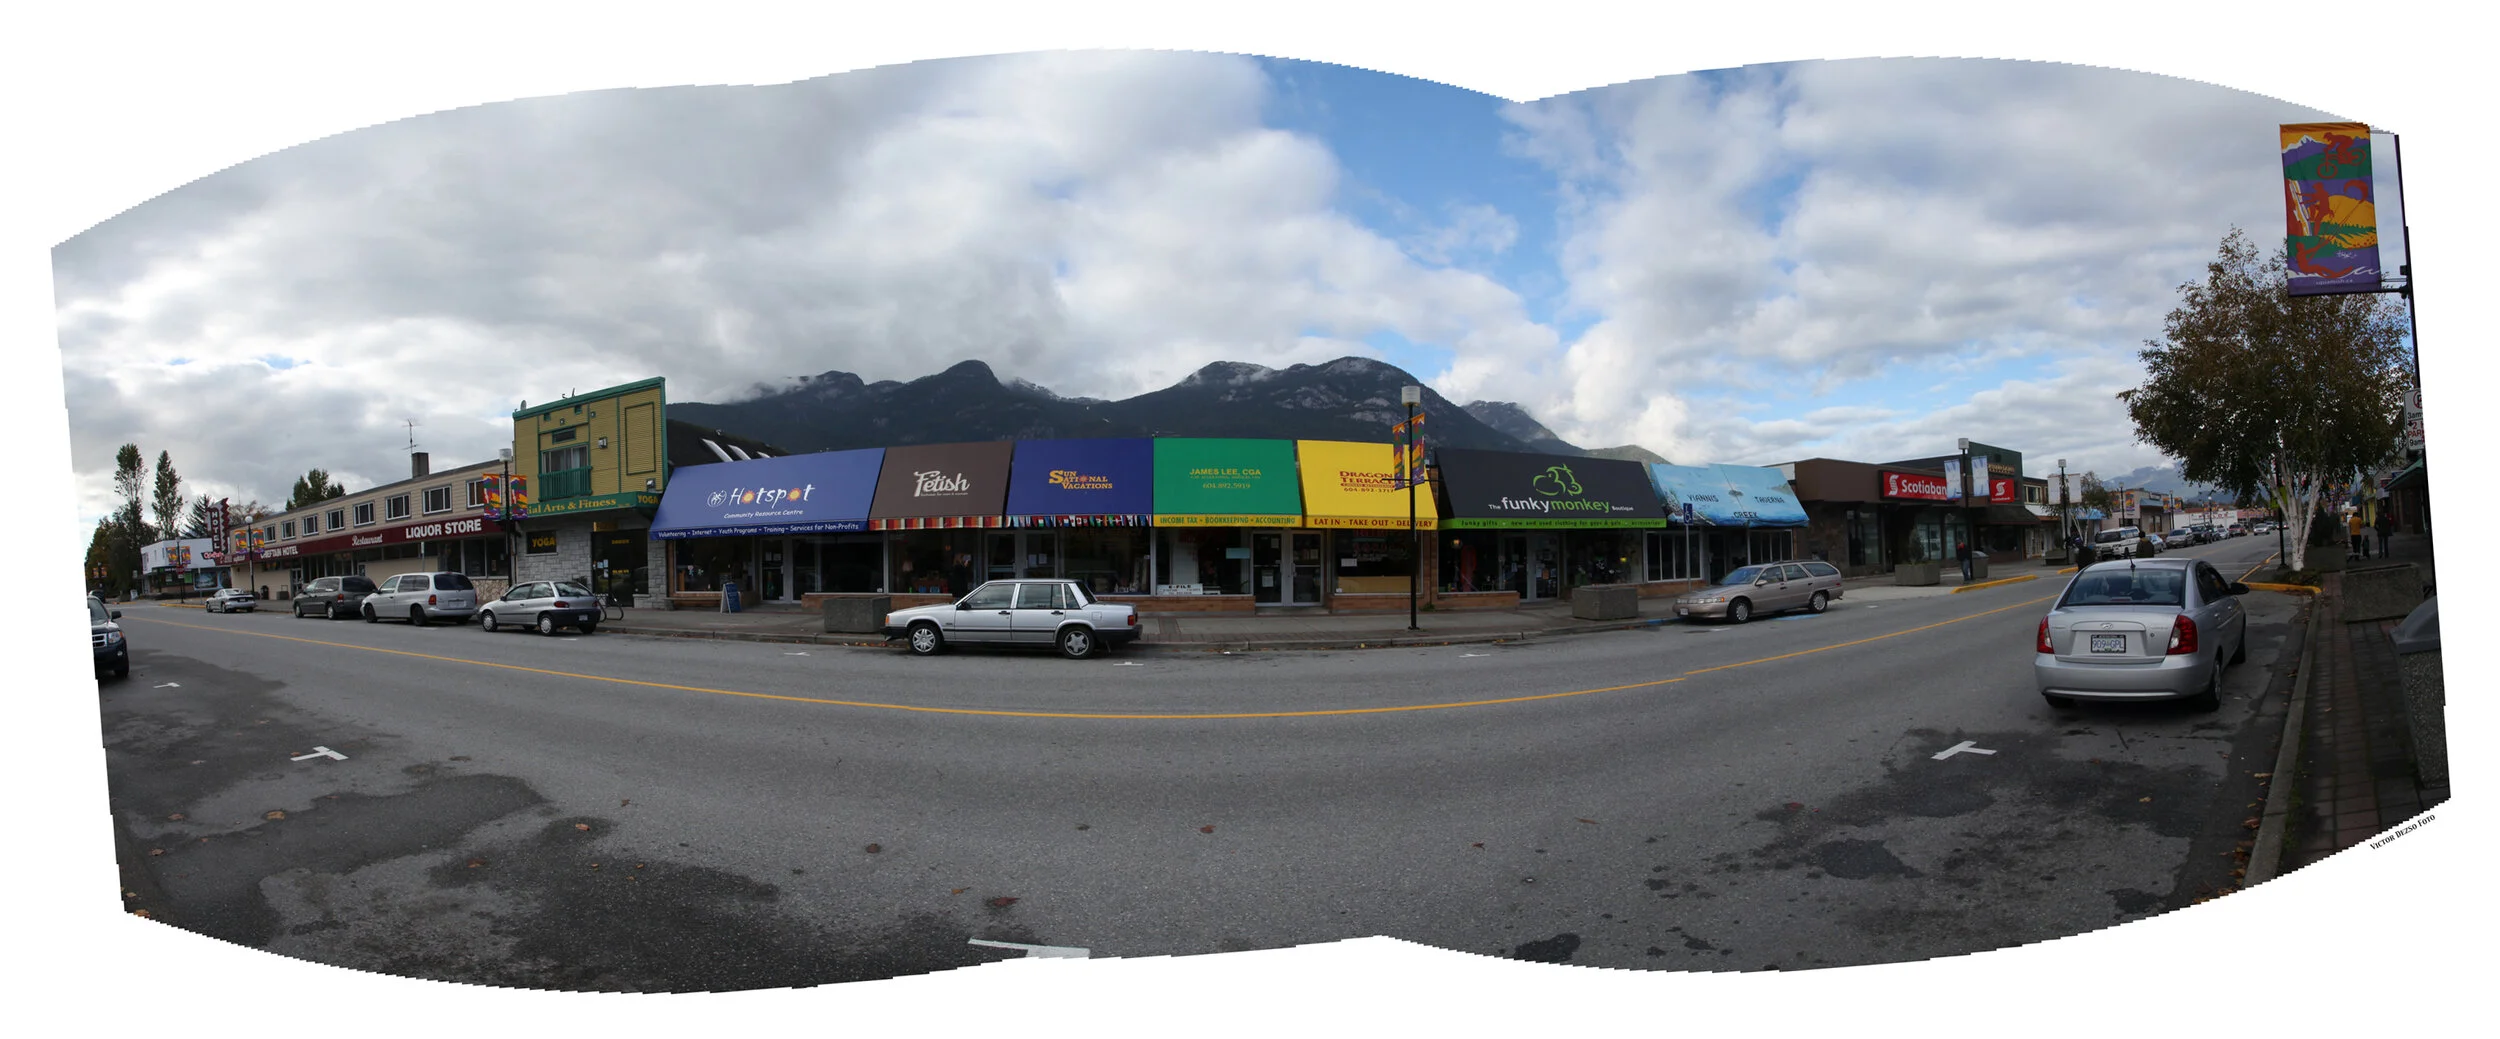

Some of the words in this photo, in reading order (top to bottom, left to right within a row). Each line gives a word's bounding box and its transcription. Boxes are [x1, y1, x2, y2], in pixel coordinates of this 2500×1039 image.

[1339, 470, 1393, 478] DRAGON
[913, 470, 970, 498] Fetish
[1901, 480, 1947, 495] Scotiaban
[637, 494, 659, 504] YOGA
[729, 484, 815, 509] Hotspot
[543, 502, 565, 513] Arts
[567, 501, 575, 510] &
[578, 498, 617, 509] Fitness
[1160, 516, 1185, 524] INCOME
[1187, 516, 1198, 524] TAX
[1205, 516, 1249, 524] BOOKKEEPING
[1255, 516, 1296, 524] ACCOUNTING
[212, 511, 220, 549] HOTEL
[405, 523, 442, 539] LIQUOR
[444, 519, 482, 535] STORE
[532, 537, 556, 547] YOGA
